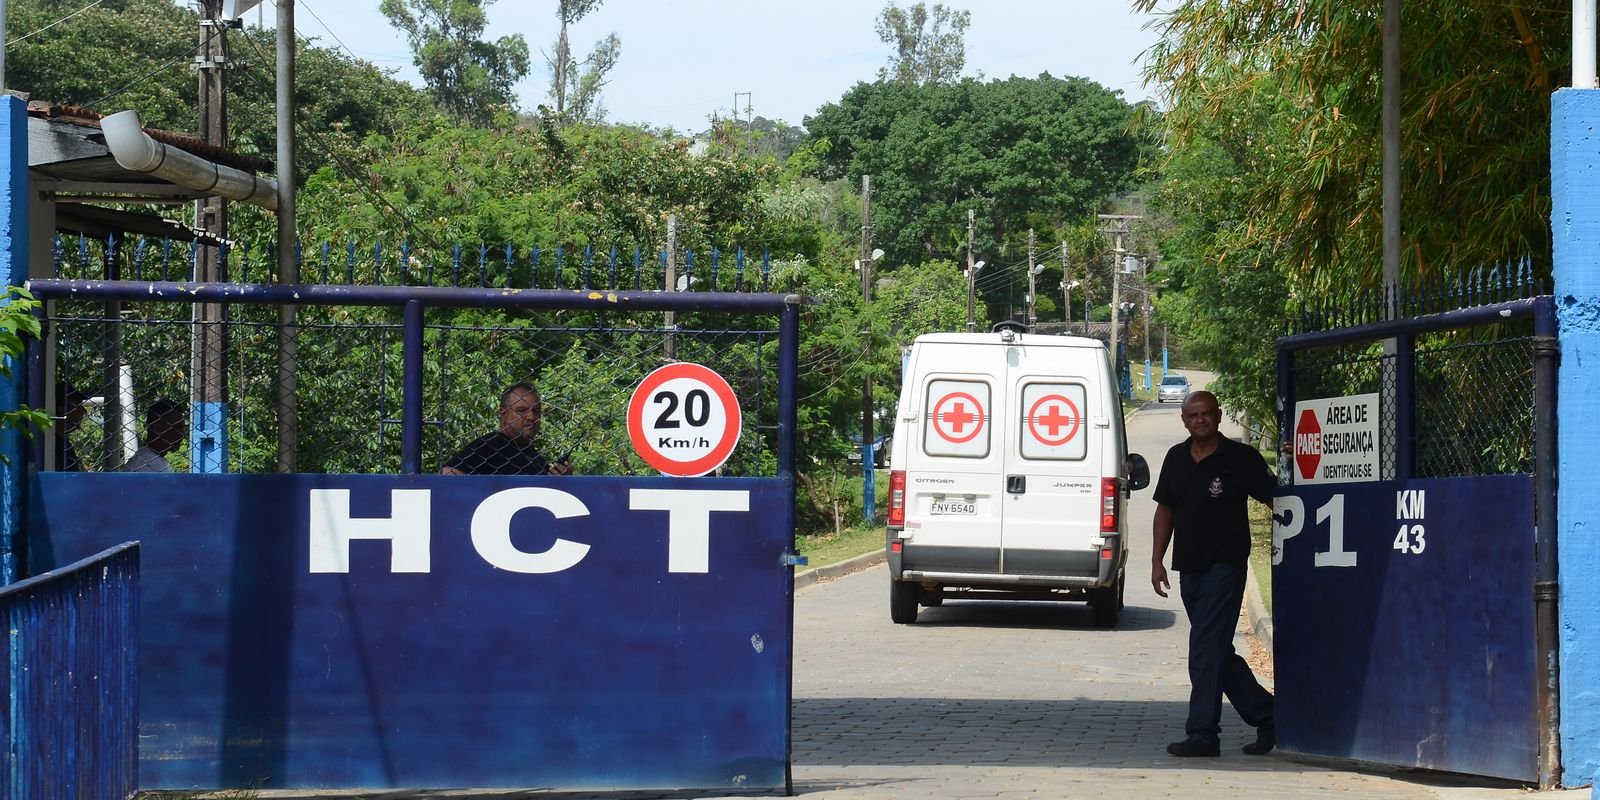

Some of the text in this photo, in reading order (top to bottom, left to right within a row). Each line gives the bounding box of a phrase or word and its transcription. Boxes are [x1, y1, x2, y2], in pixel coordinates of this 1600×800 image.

[653, 389, 710, 429] 20
[1326, 402, 1367, 425] ÁREA DE
[658, 437, 710, 448] Km/h
[1297, 432, 1321, 455] PARE
[1323, 431, 1373, 458] SEGURANÇA
[1323, 463, 1372, 479] IDENTIFIQUE-SE
[1396, 490, 1425, 520] KM
[309, 487, 750, 573] HCT
[1393, 524, 1426, 554] 43
